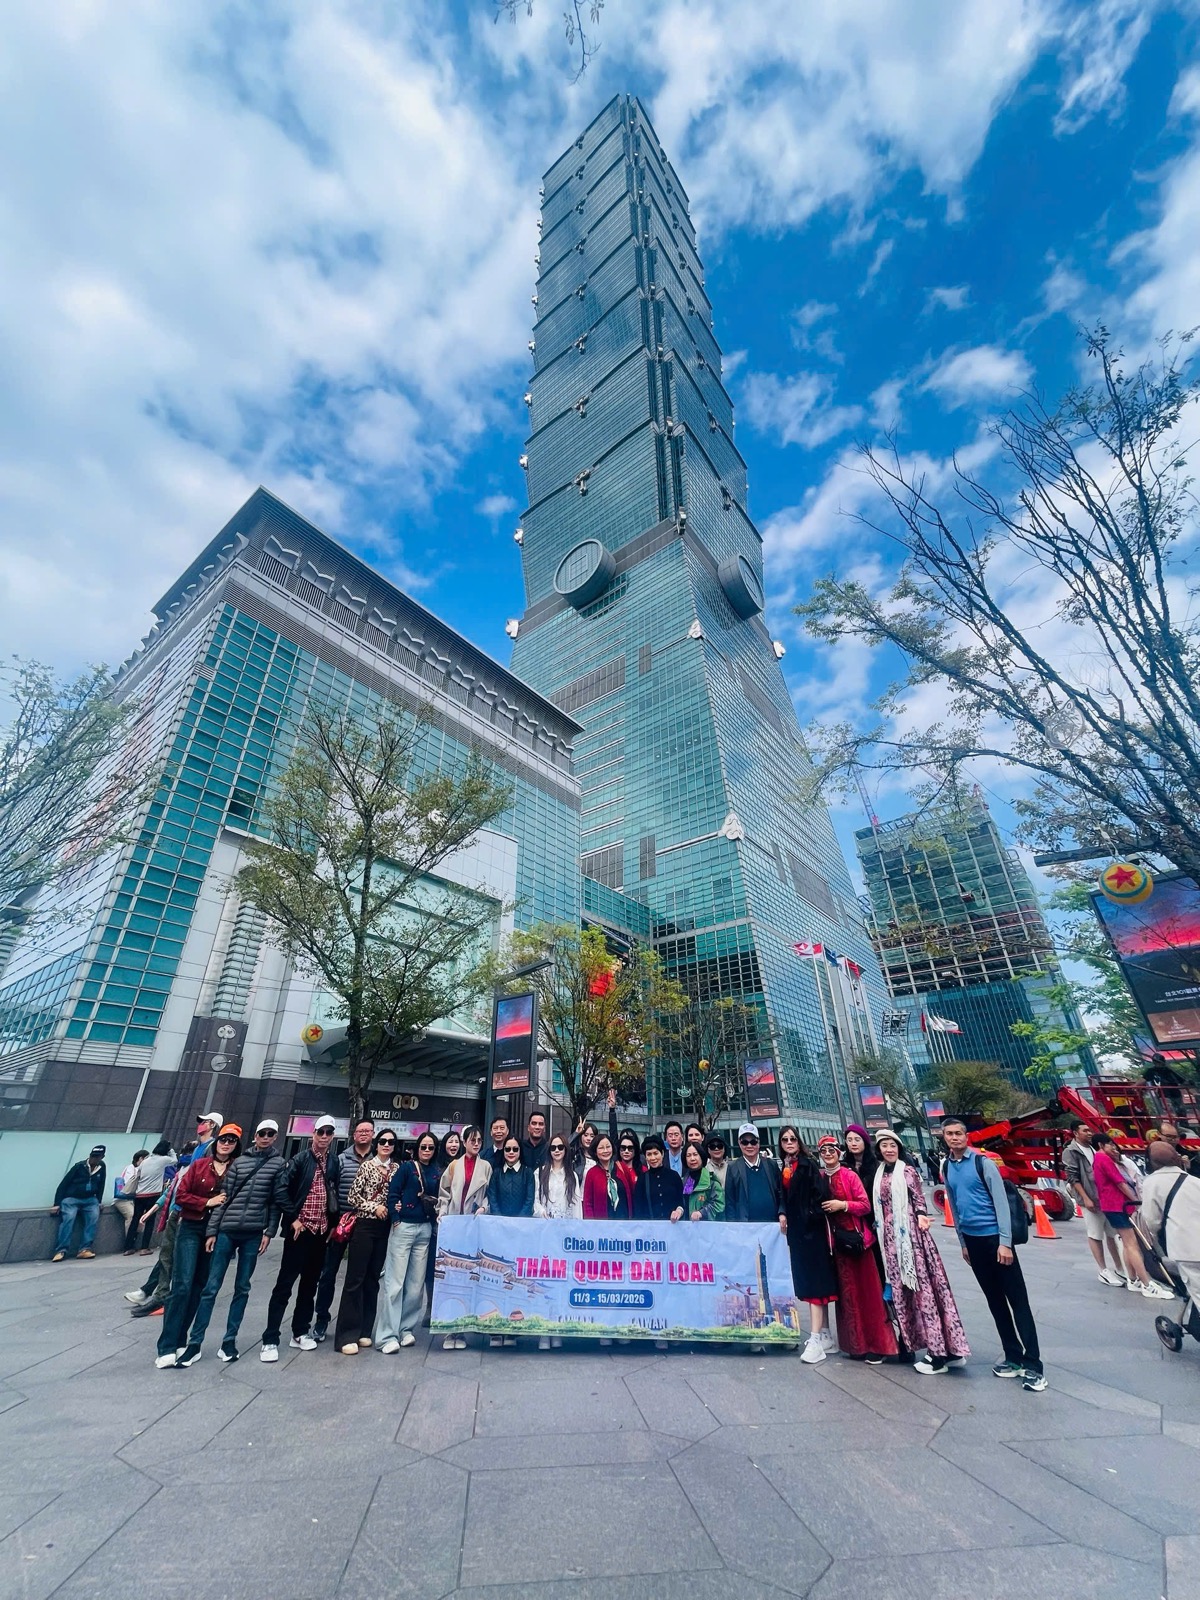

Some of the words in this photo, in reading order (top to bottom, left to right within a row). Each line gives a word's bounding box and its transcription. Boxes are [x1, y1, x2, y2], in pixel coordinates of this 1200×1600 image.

[370, 1110, 391, 1119] TAIPEI
[392, 1111, 402, 1120] 101
[563, 1236, 595, 1251] Chào
[598, 1237, 632, 1253] Mừng
[635, 1238, 667, 1252] Đoàn
[516, 1256, 567, 1279] THĂM
[574, 1260, 623, 1282] QUAN
[629, 1258, 662, 1282] ĐÀI
[669, 1262, 715, 1283] LOAN
[573, 1293, 591, 1304] 11/3
[597, 1294, 645, 1304] 15/03/2026
